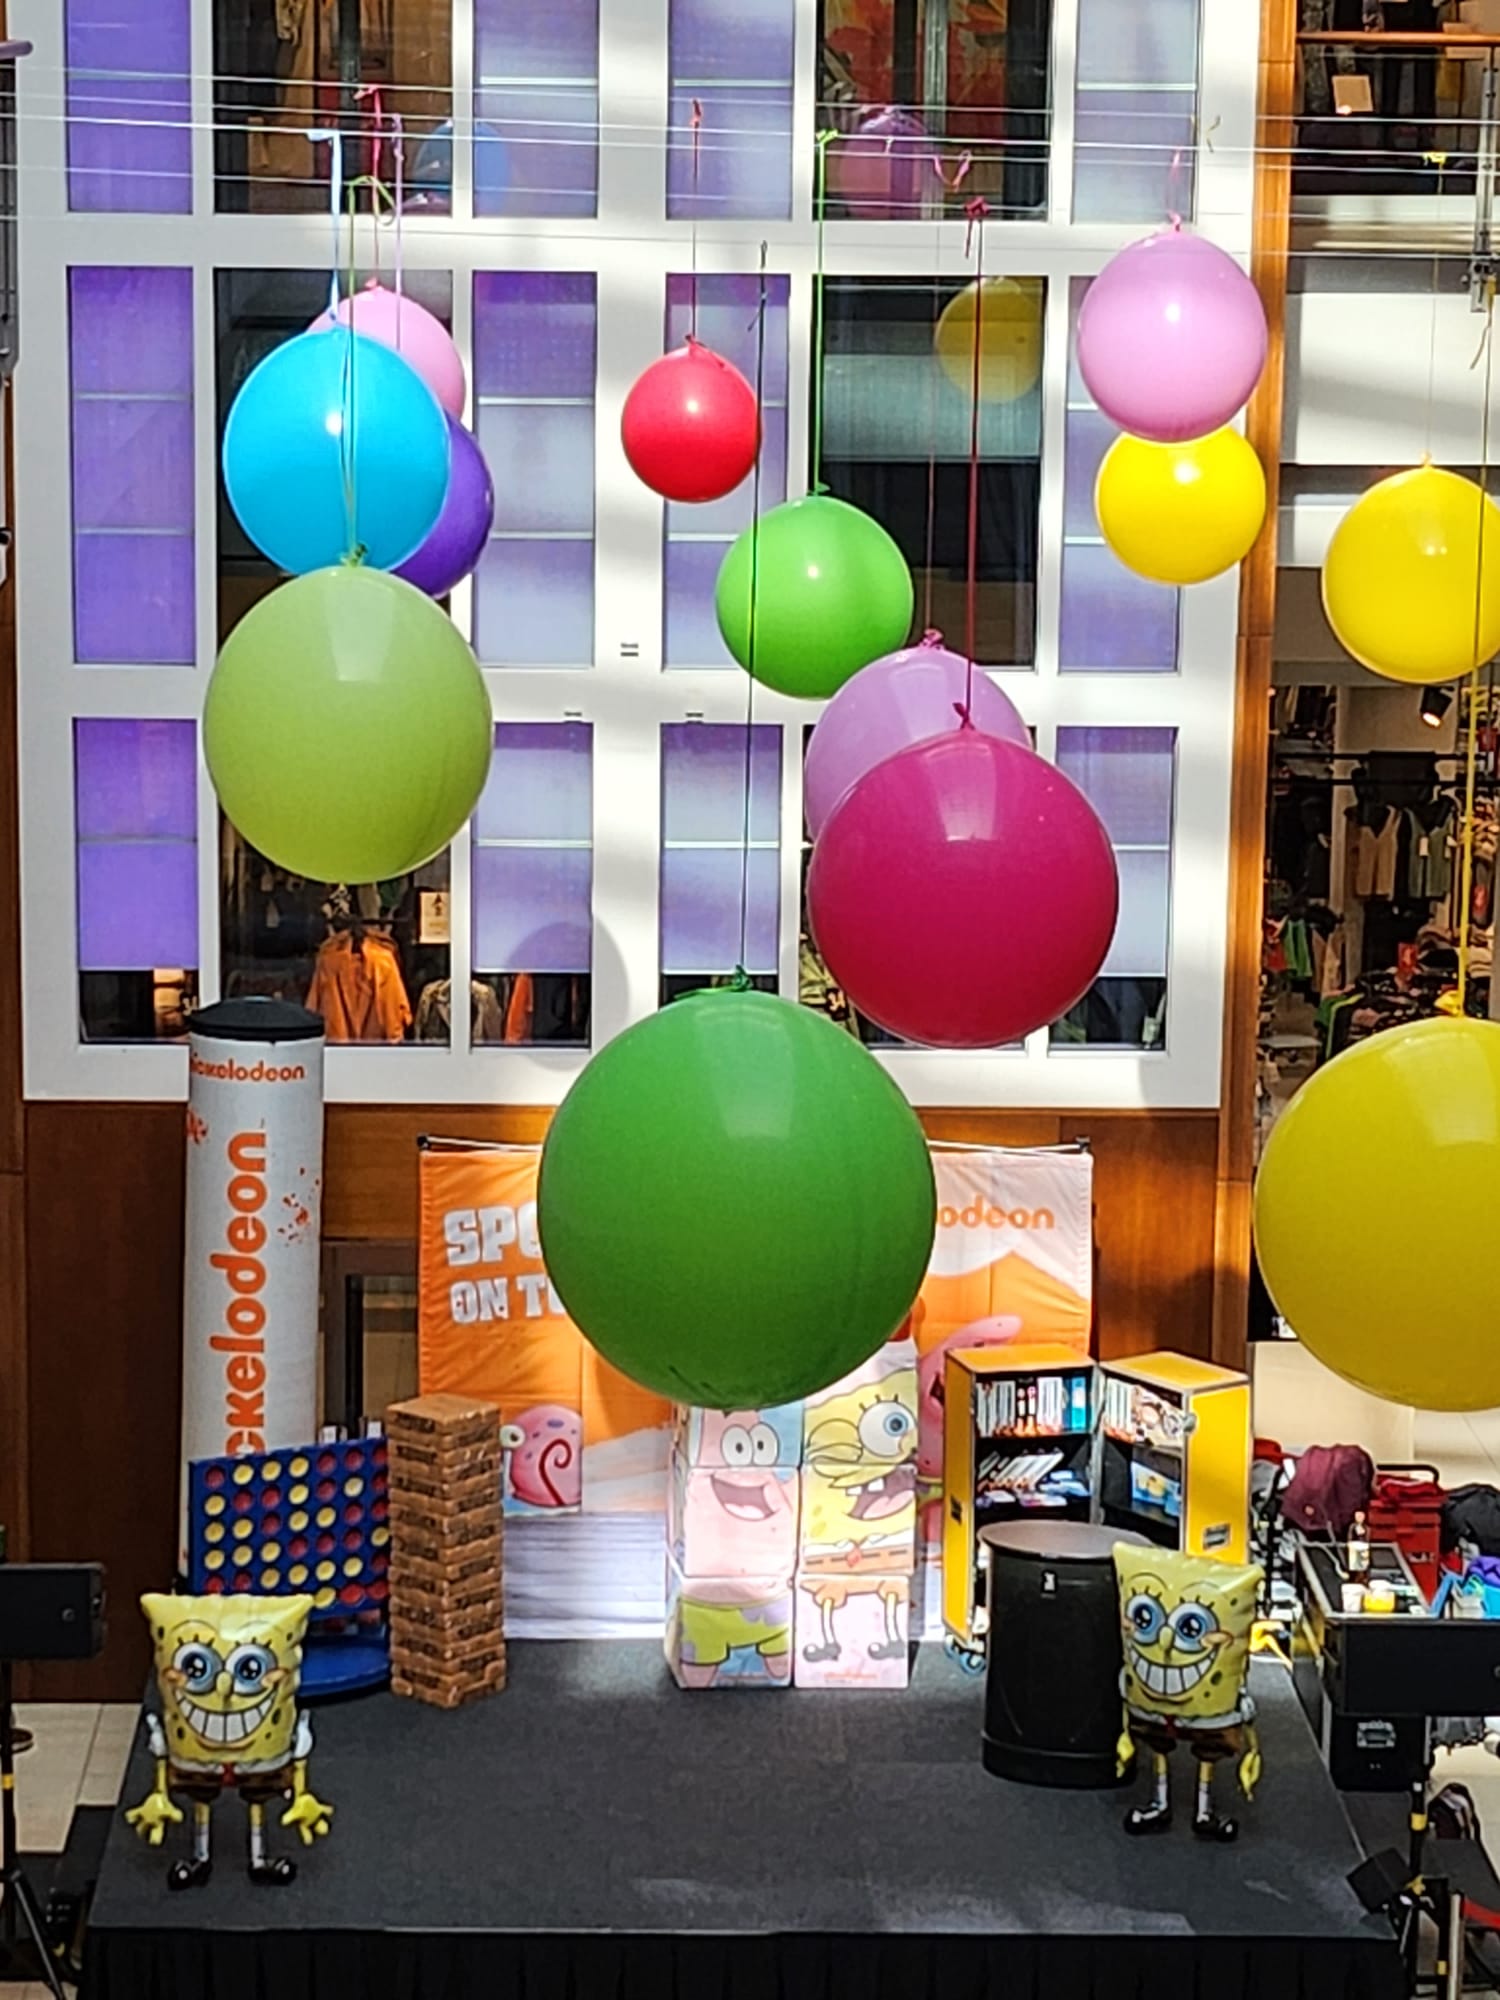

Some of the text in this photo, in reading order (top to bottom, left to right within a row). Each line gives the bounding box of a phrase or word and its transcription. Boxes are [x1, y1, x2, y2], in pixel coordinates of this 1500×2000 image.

[938, 1194, 1055, 1229] odeon
[209, 1131, 267, 1456] ckelodeon
[450, 1277, 509, 1325] ON
